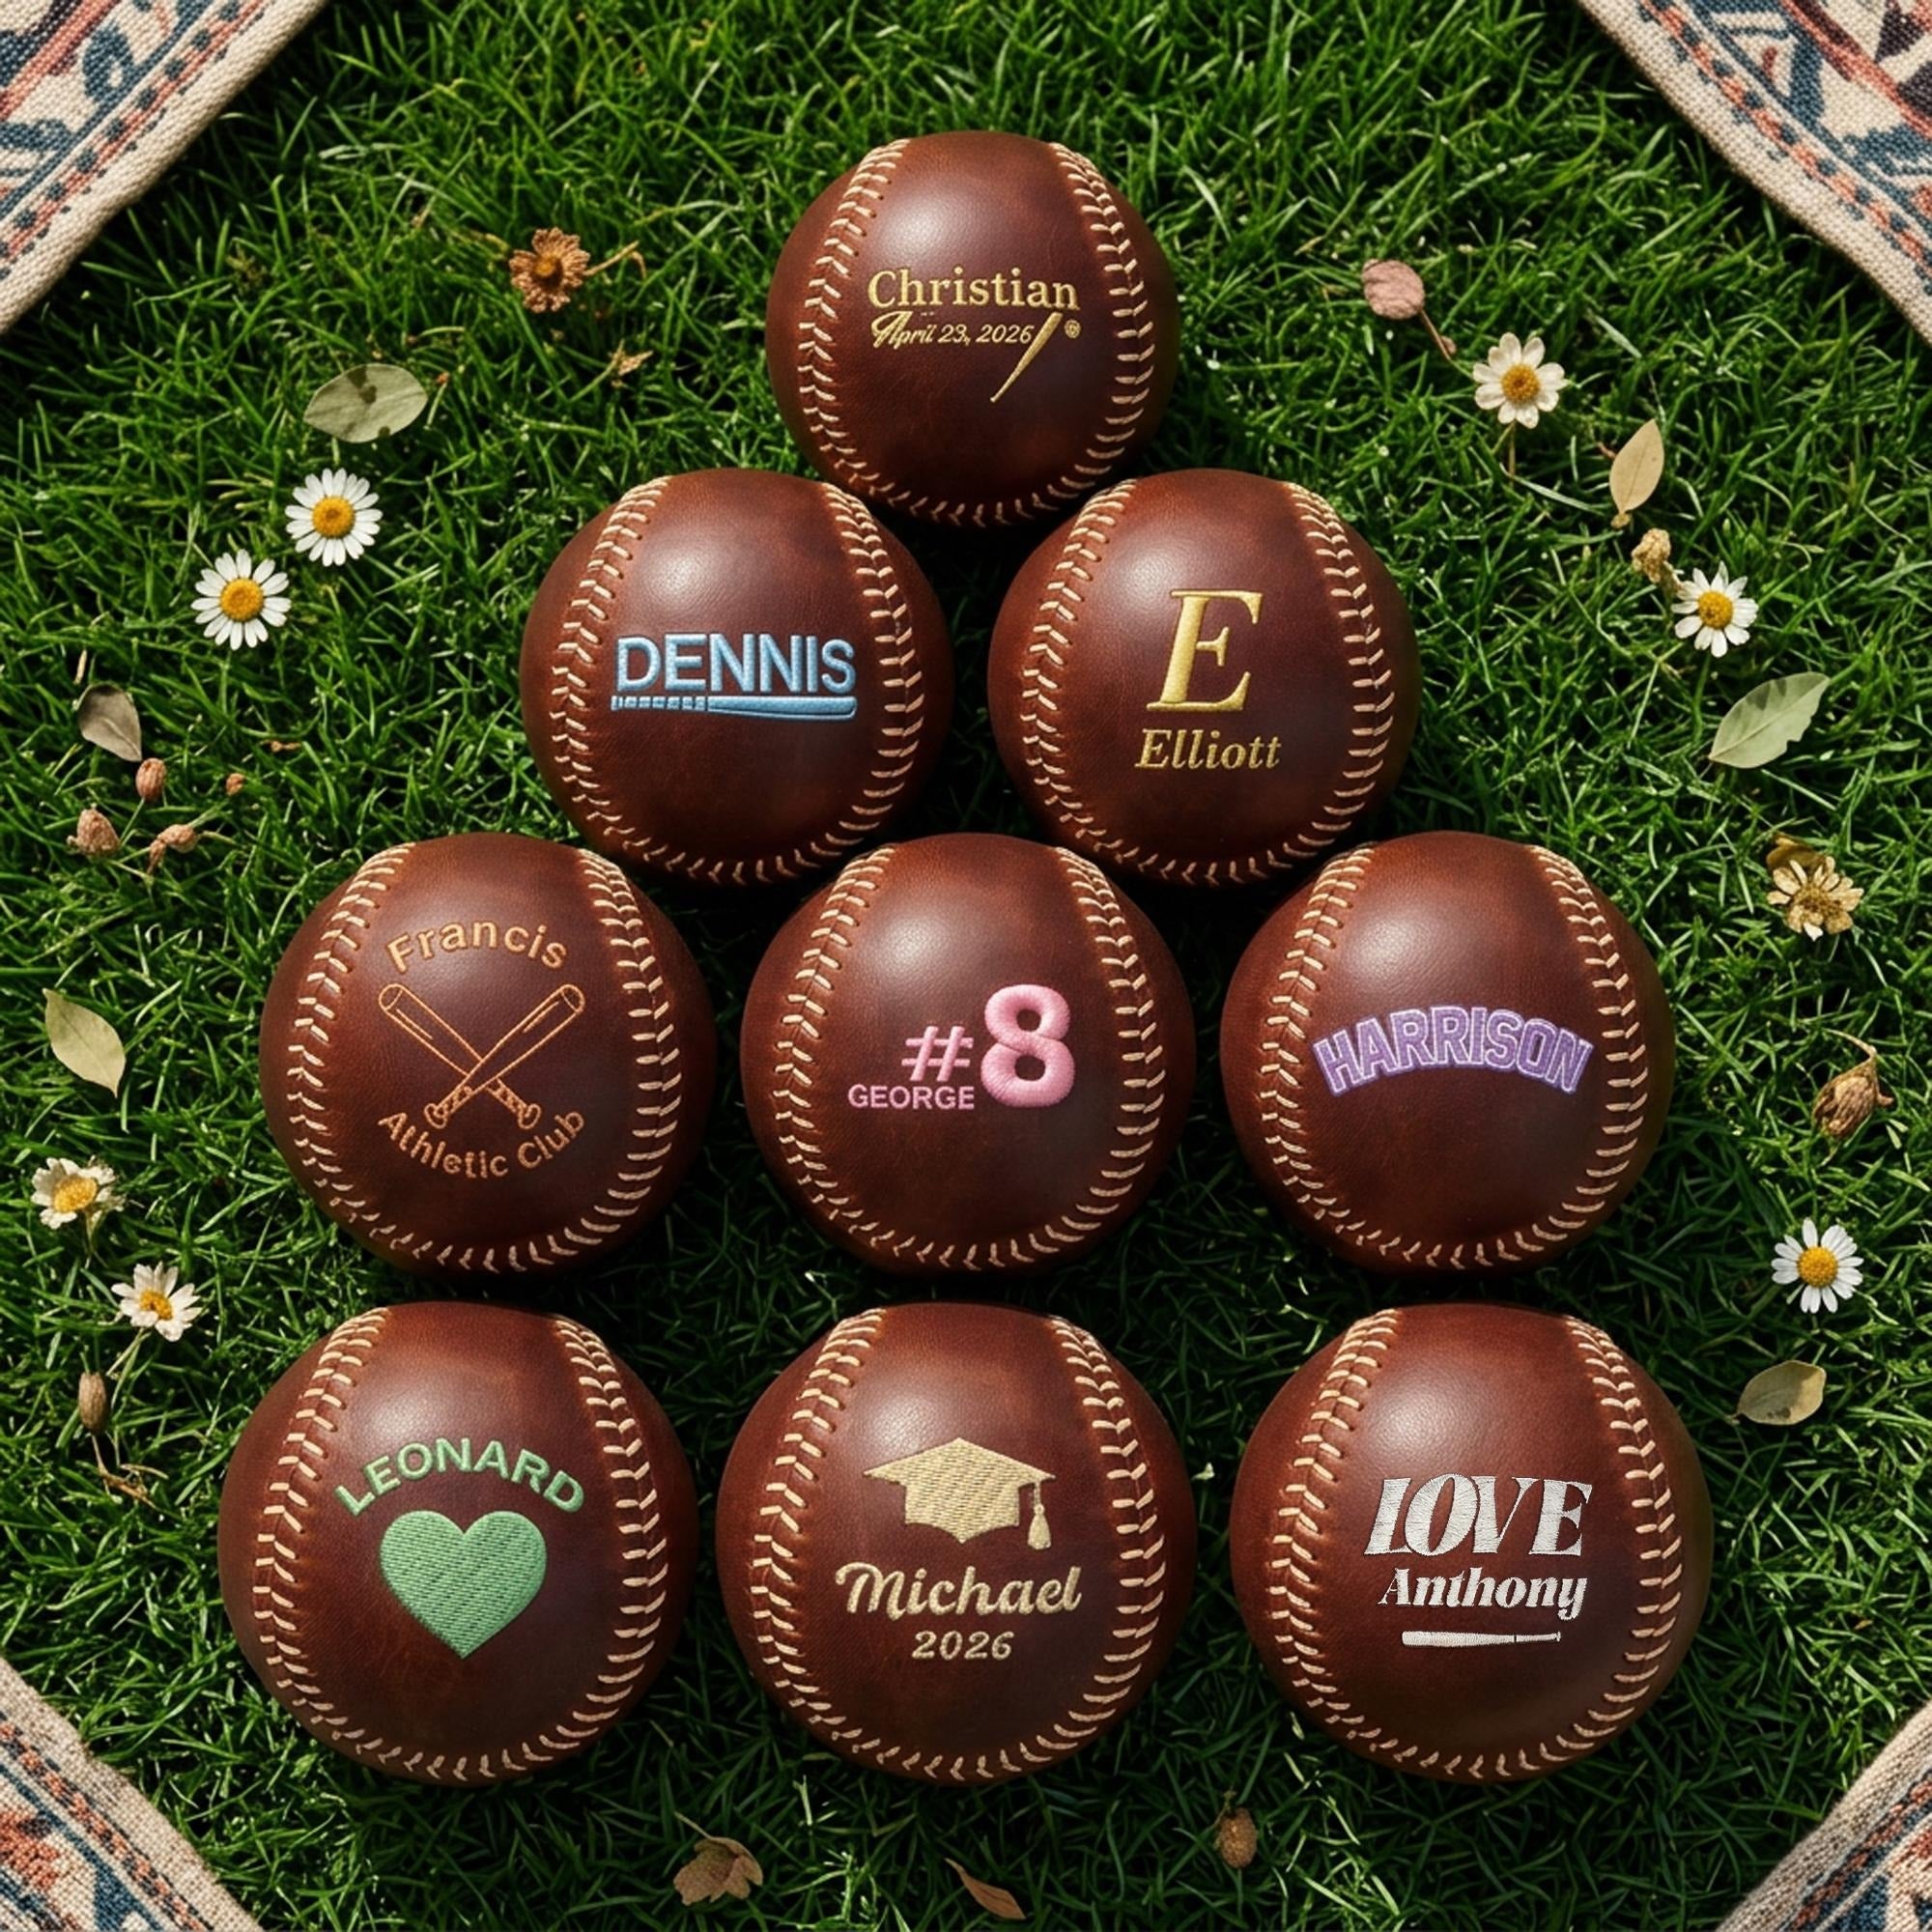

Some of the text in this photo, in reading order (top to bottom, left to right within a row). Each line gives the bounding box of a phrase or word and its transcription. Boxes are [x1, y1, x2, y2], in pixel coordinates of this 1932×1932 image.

[867, 266, 1080, 310] Christian
[870, 310, 1035, 350] April 23, 2026
[616, 633, 856, 694] DENNIS
[1147, 590, 1264, 711] E
[1134, 728, 1282, 769] Elliott
[387, 920, 567, 973] Francis
[1313, 1006, 1594, 1096] HARRISON
[848, 1084, 975, 1110] GEORGE
[378, 1111, 584, 1179] Athletic Club
[336, 1437, 584, 1516] LEONARD
[1364, 1473, 1593, 1556] LOVE
[836, 1562, 1082, 1621] Michael
[1378, 1567, 1588, 1621] Anthony
[912, 1631, 1014, 1660] 2026
